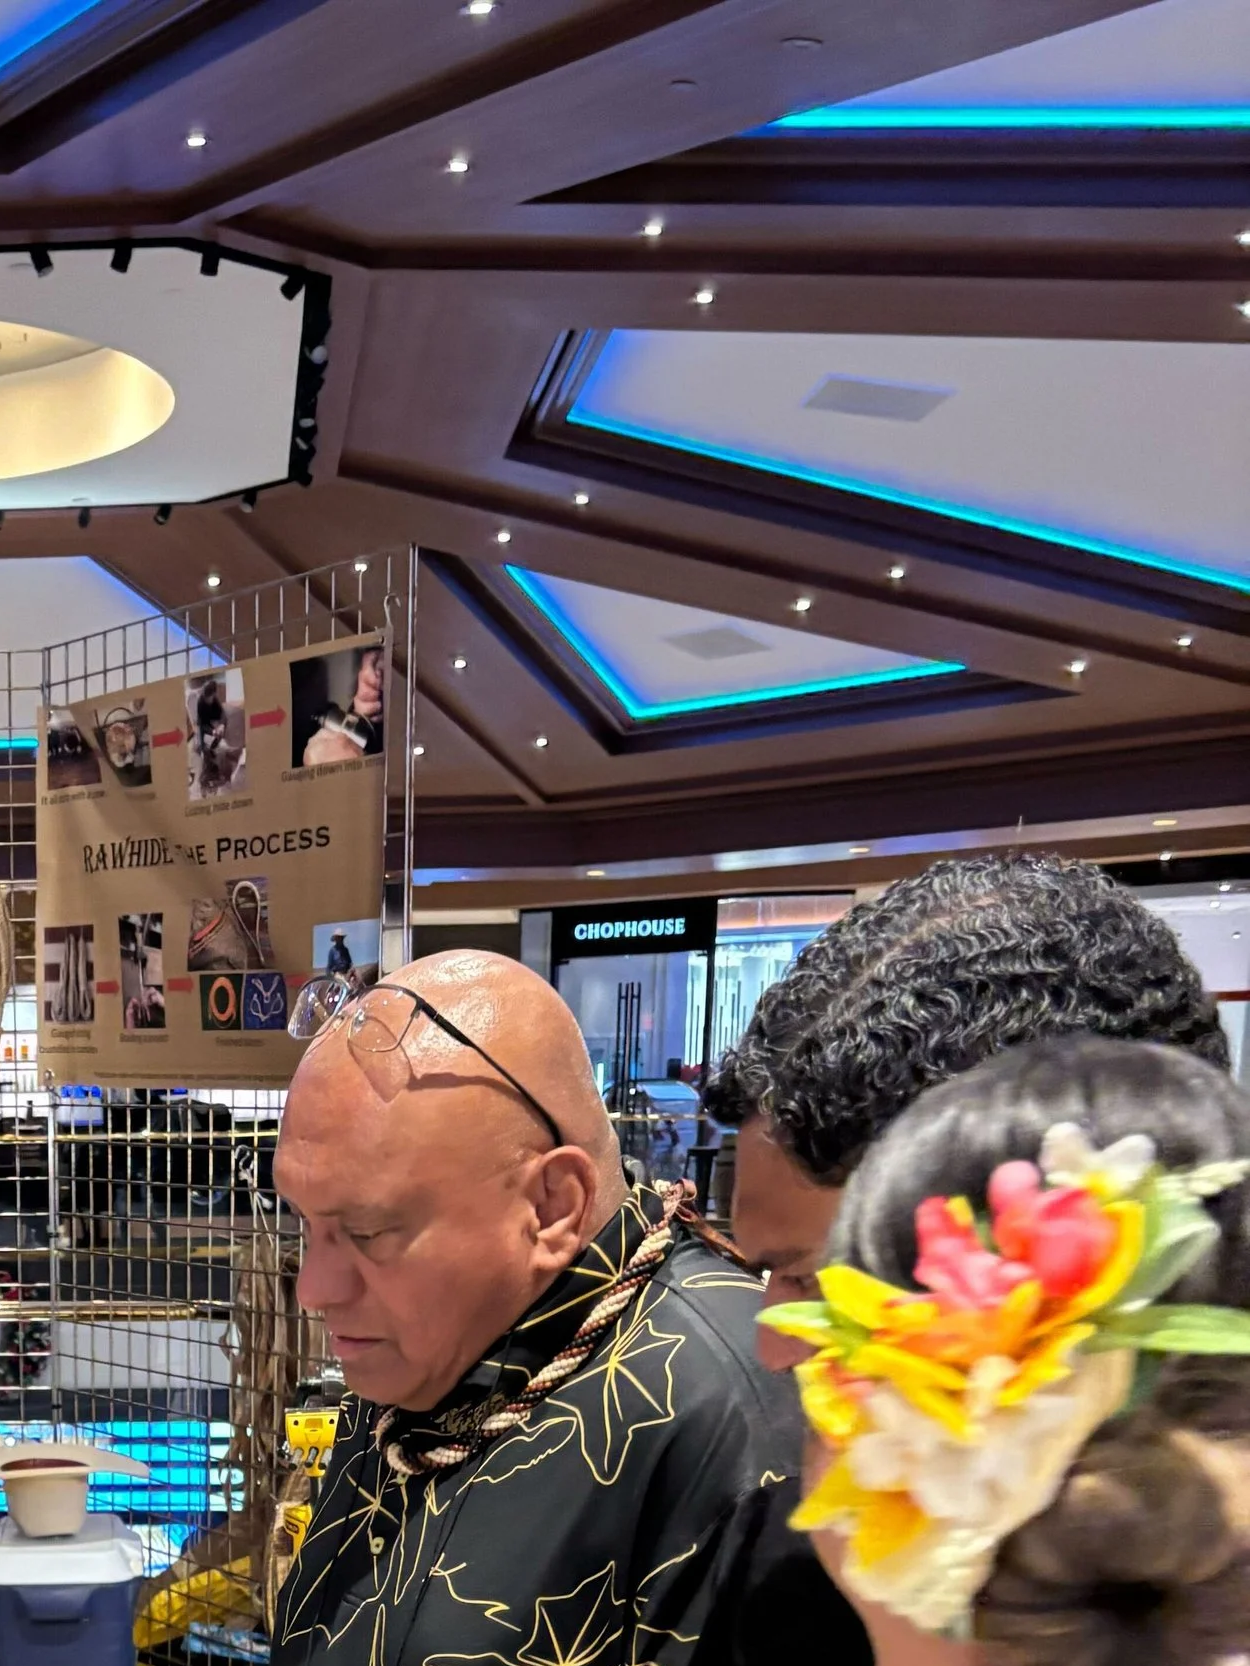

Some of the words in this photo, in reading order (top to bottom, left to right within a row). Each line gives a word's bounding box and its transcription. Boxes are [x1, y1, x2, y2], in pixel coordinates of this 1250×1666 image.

[83, 836, 174, 875] RAWHIDE
[216, 826, 331, 863] PROCESS
[573, 917, 687, 941] CHOPHOUSE
